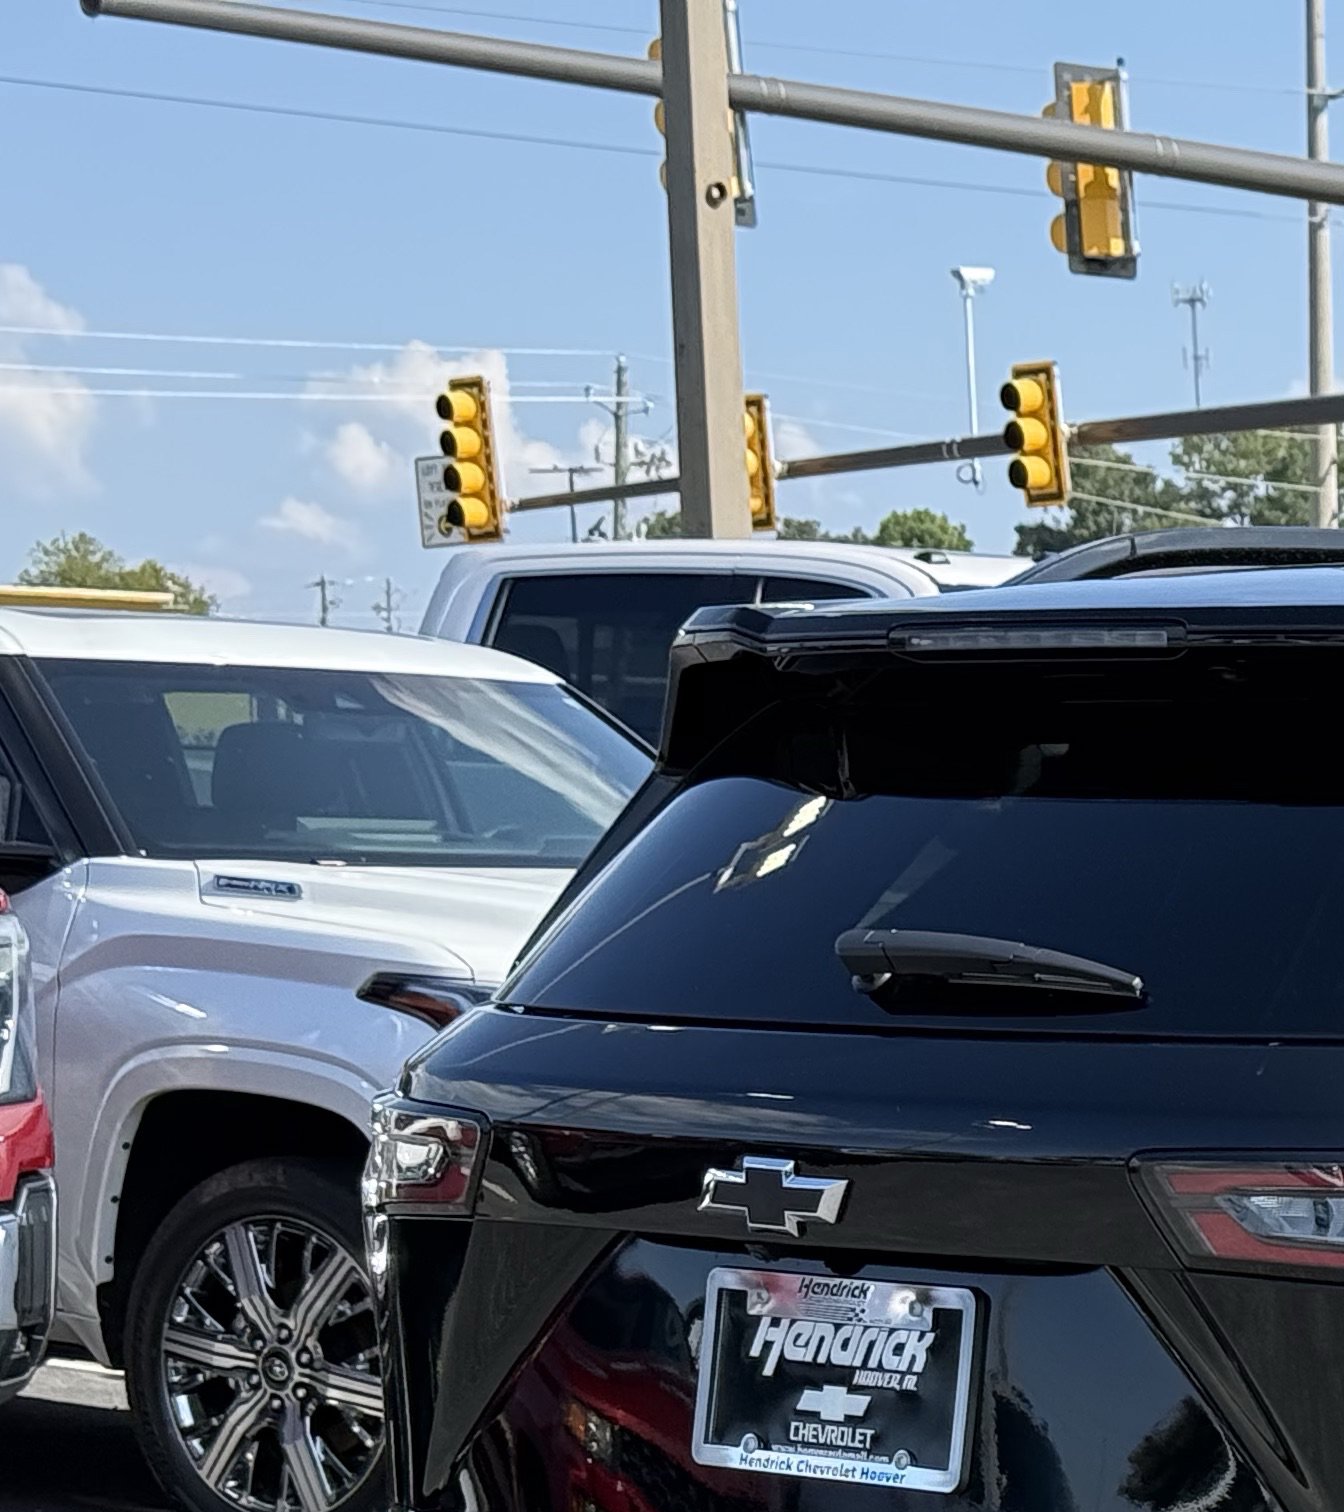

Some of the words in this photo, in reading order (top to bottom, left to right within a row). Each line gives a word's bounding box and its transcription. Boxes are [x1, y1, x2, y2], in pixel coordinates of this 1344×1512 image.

[798, 1276, 871, 1299] Hendrick
[749, 1316, 936, 1376] Hendrick
[789, 1421, 875, 1449] CHEVROLET
[738, 1453, 794, 1474] Hendrick
[796, 1460, 856, 1479] Chevrolet
[860, 1468, 906, 1485] Hoover
